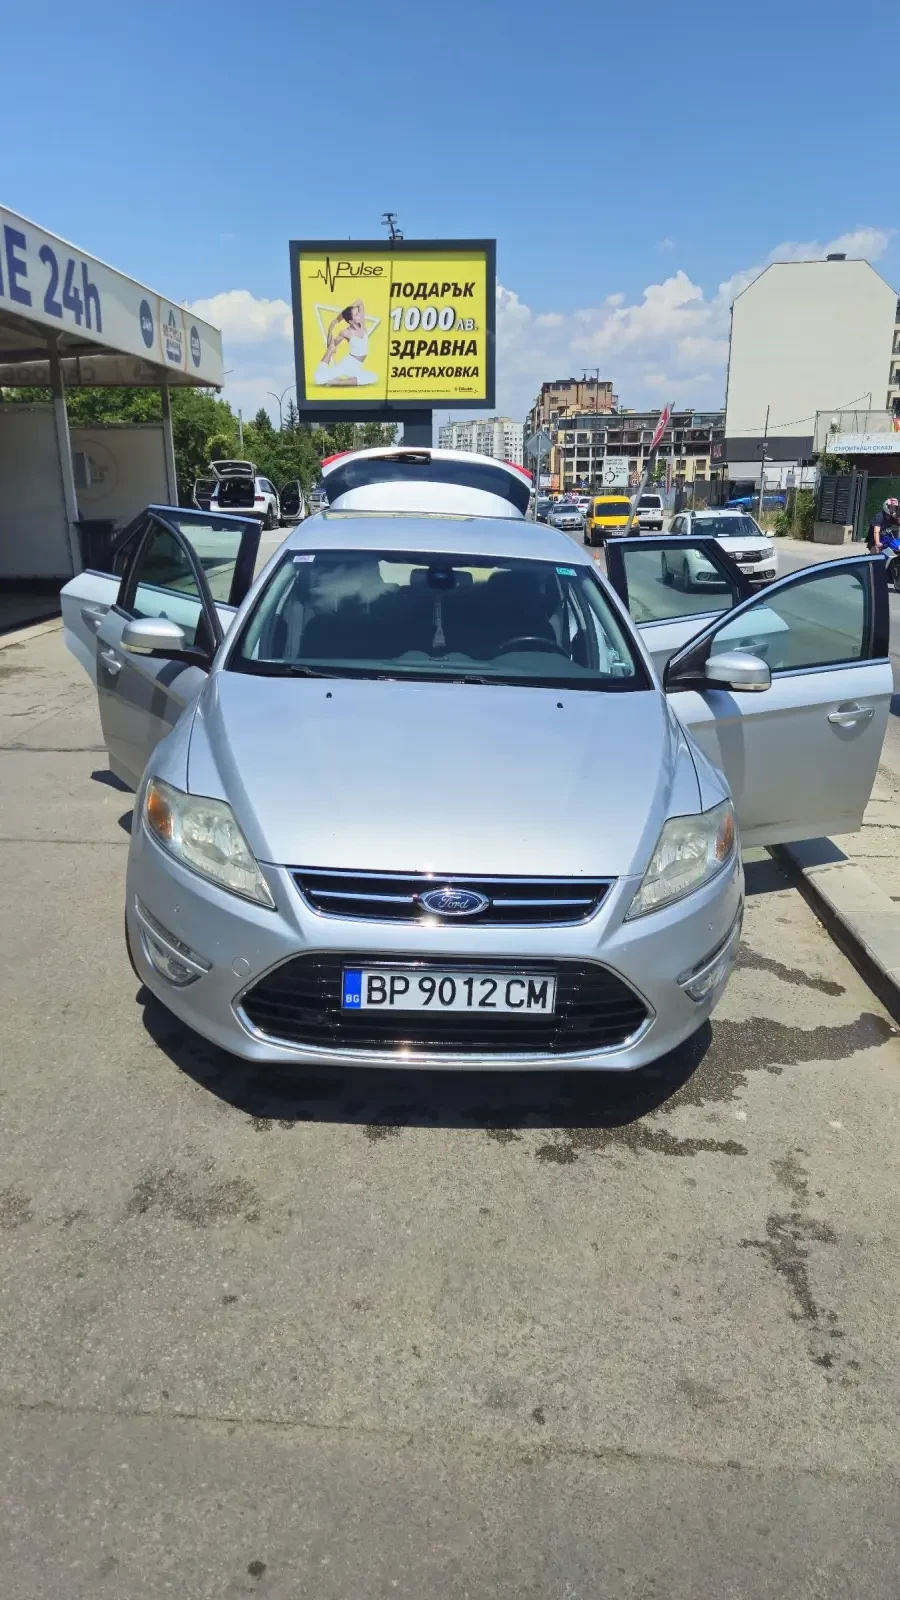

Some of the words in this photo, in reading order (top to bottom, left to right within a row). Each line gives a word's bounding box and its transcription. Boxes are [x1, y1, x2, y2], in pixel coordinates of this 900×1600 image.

[335, 261, 384, 276] Pulse
[38, 244, 103, 333] 24h
[389, 282, 476, 300] ПОДАРЪК
[390, 306, 457, 331] 1000
[389, 340, 478, 360] ЗДРАВНА
[391, 366, 479, 378] ЗАСТРАХОВКА
[437, 895, 469, 909] Ford
[345, 994, 360, 1003] BG
[366, 975, 410, 1005] BP
[418, 976, 498, 1007] 9012
[505, 979, 549, 1009] CM
